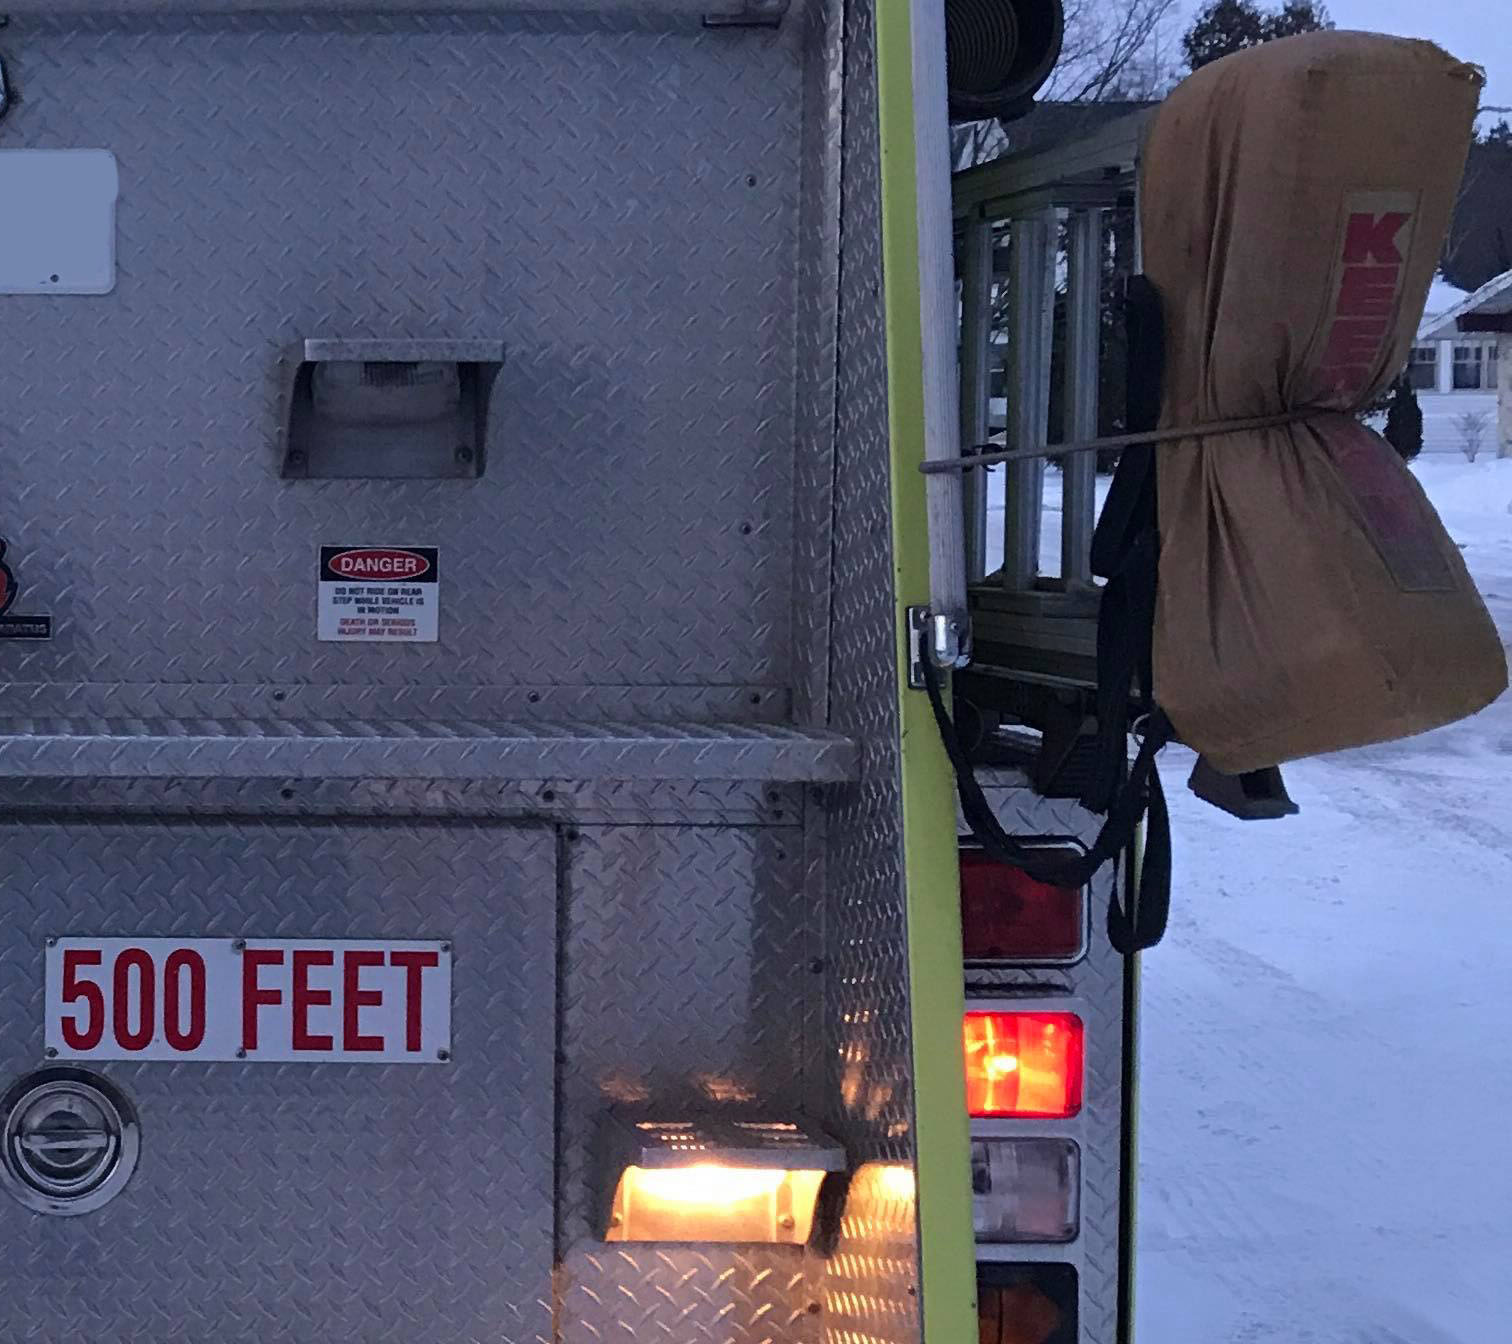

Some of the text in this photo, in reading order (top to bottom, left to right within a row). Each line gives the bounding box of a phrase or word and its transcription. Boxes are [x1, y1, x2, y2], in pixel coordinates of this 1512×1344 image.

[340, 557, 417, 572] DANGER
[348, 587, 364, 596] NOT
[387, 587, 399, 596] ON
[400, 587, 423, 596] REAR
[332, 596, 352, 605] STEP
[382, 596, 414, 605] VEHICLE
[415, 596, 424, 605] IS
[367, 606, 400, 614] MOTION
[62, 948, 206, 1051] 500
[242, 950, 438, 1051] FEET
